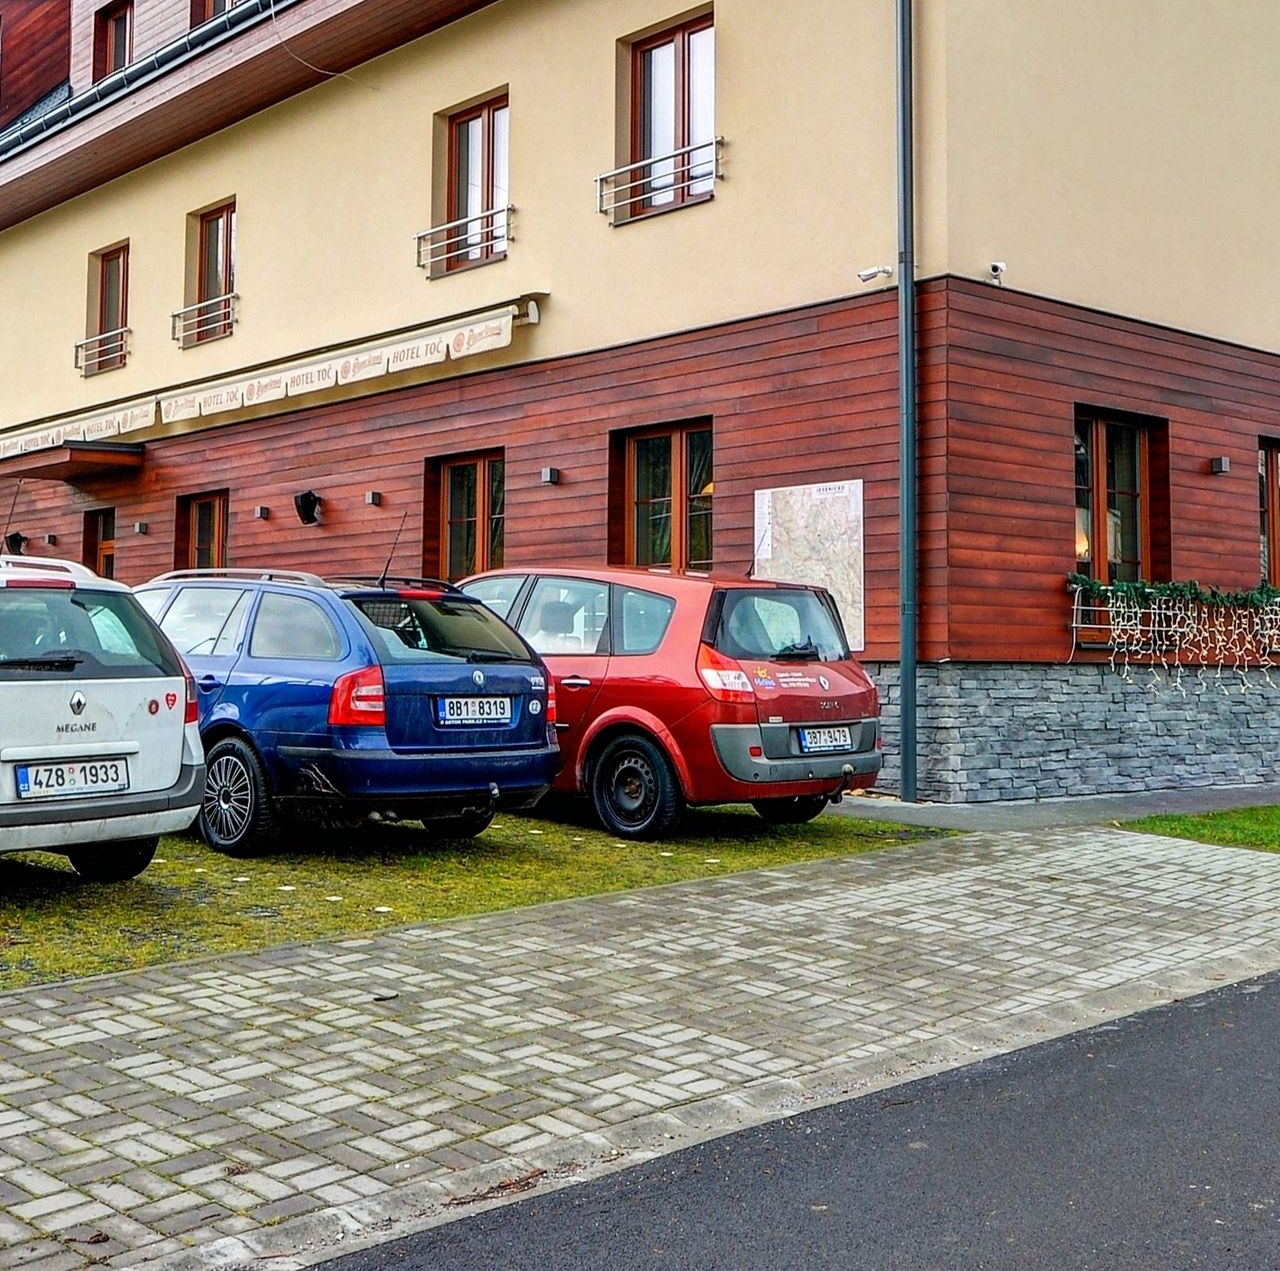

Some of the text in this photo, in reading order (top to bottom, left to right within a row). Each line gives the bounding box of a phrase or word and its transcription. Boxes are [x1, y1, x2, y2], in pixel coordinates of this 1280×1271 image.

[392, 345, 421, 364] HOTEL
[424, 337, 443, 357] TOČ
[290, 371, 314, 388] HOTEL
[317, 364, 333, 381] TOČ
[203, 392, 224, 408] HOTEL
[448, 700, 506, 717] 8B1 8319
[56, 722, 97, 733] MEGANE
[807, 729, 847, 745] 3B7 9479
[33, 763, 120, 789] 4Z8 1933
